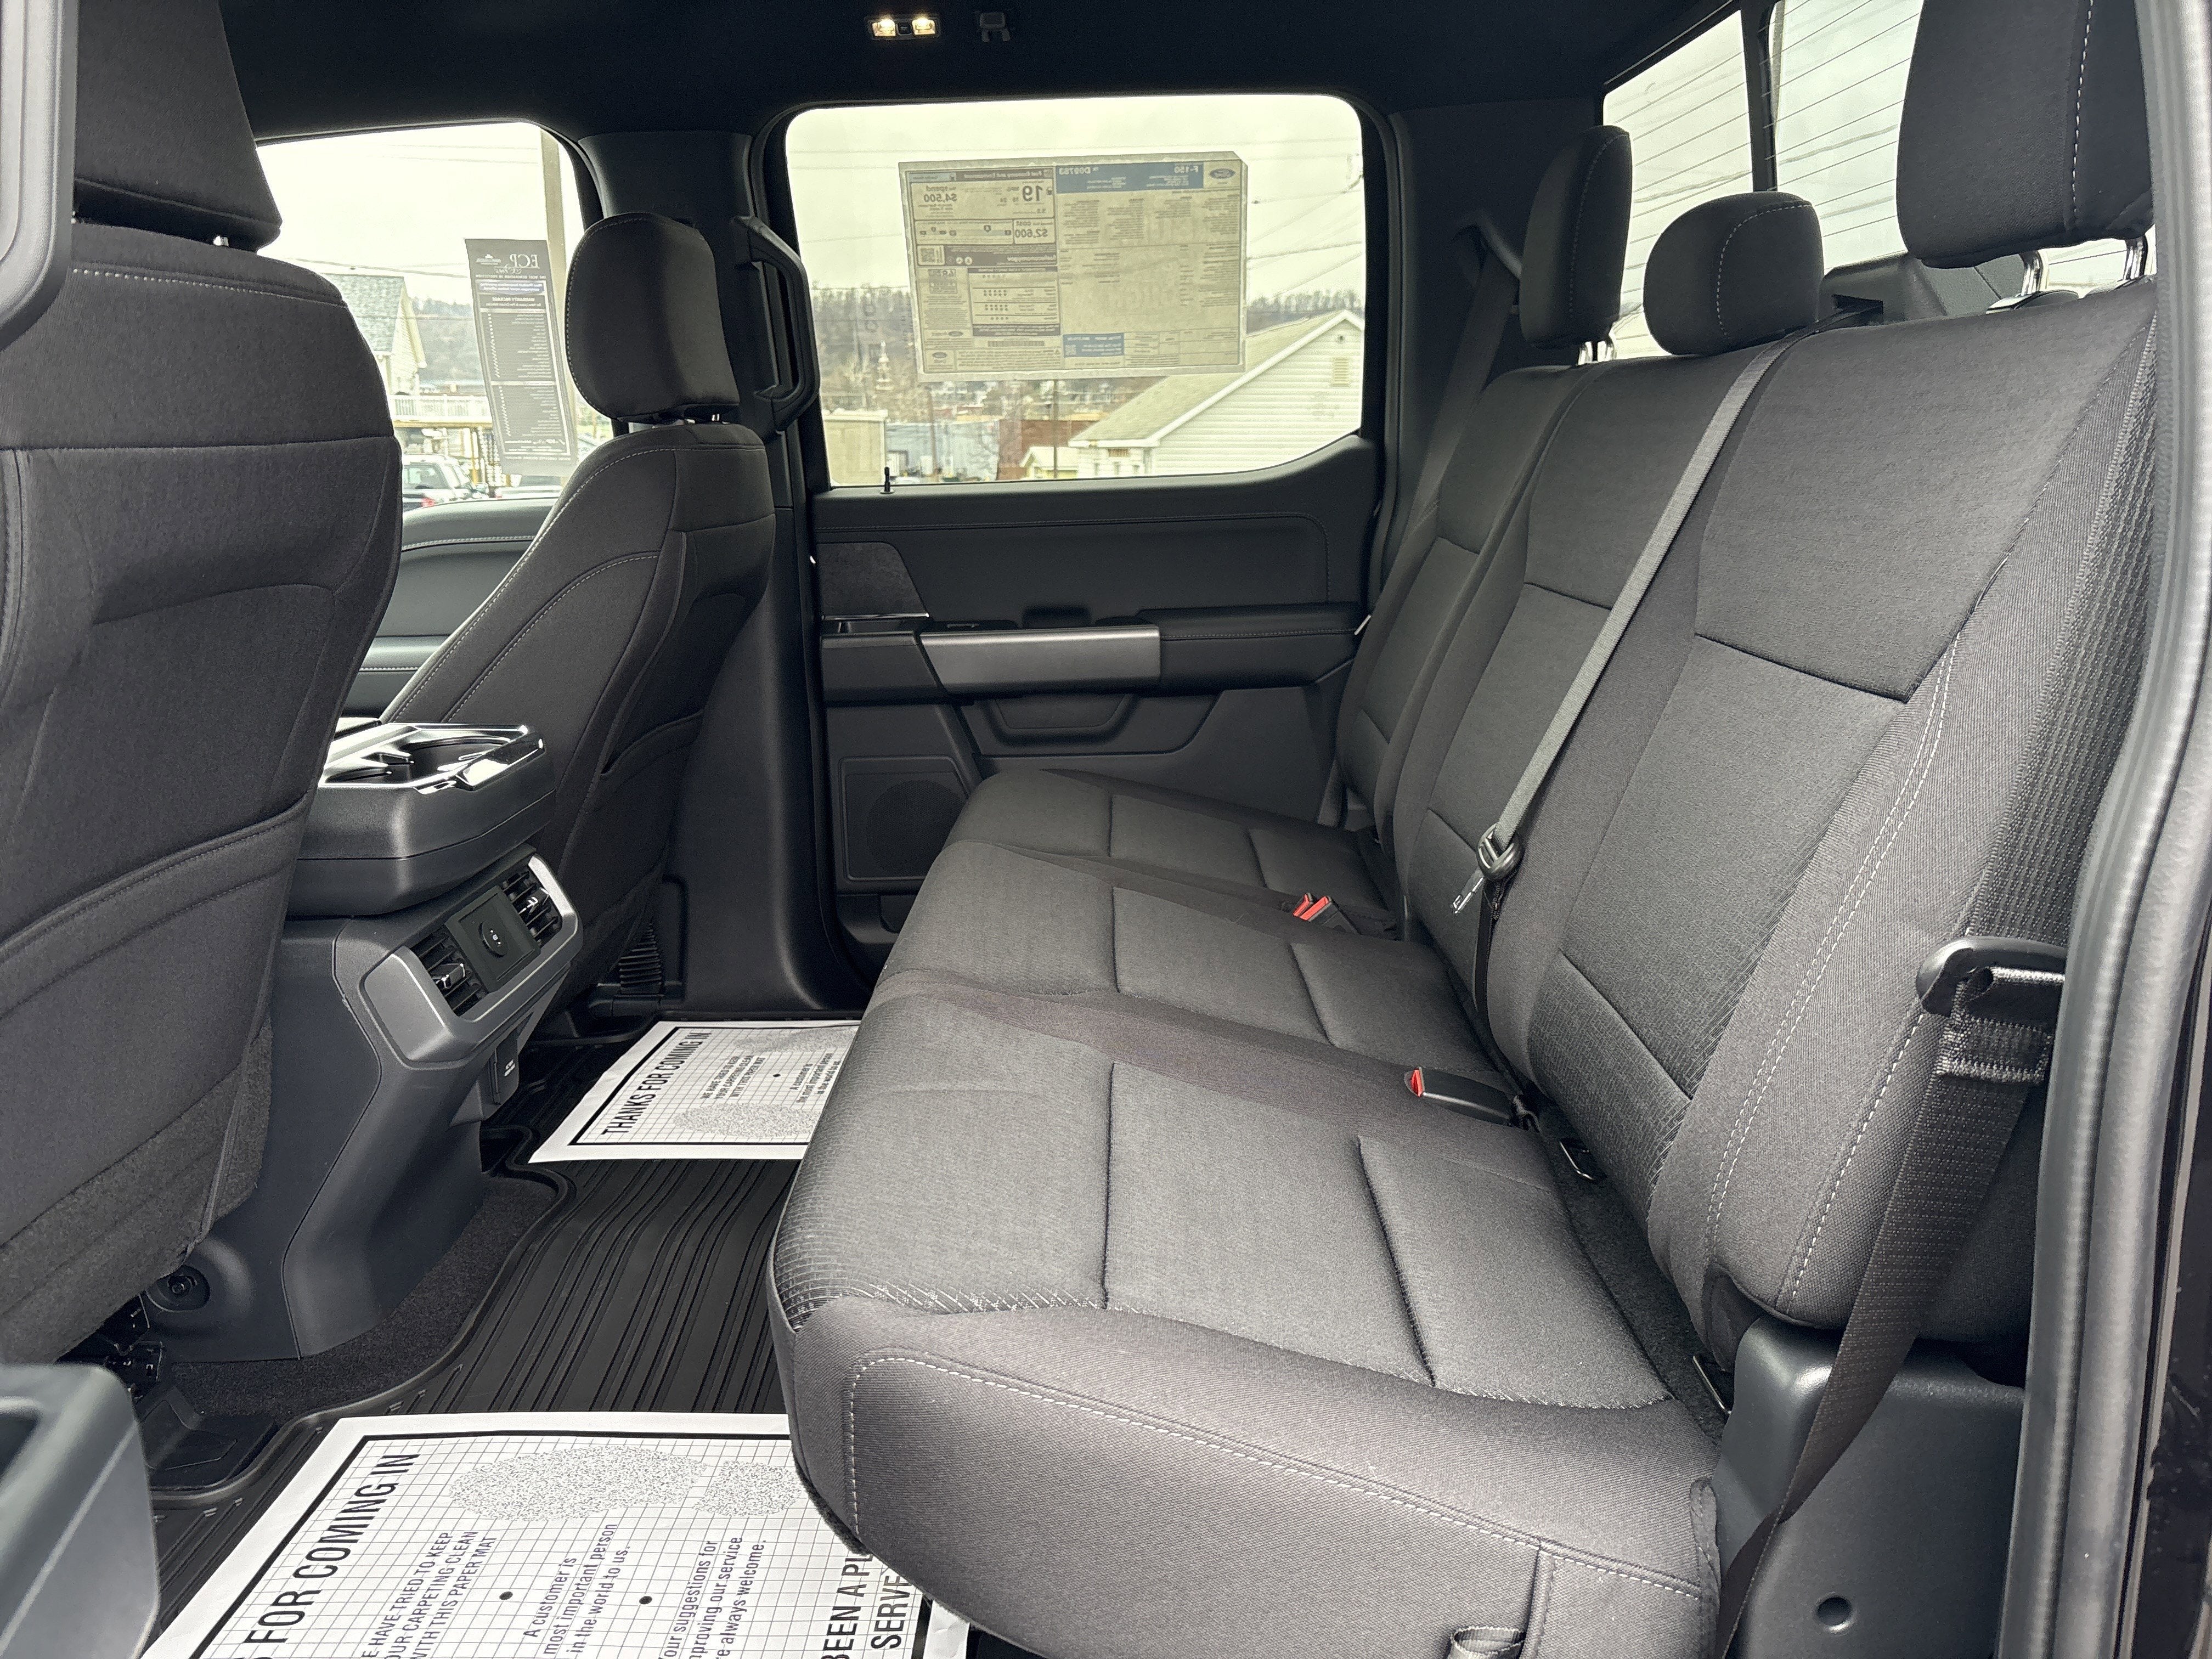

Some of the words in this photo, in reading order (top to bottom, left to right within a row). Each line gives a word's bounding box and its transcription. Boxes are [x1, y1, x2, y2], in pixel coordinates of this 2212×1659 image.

[685, 1031, 713, 1040] IN
[654, 1041, 704, 1070] COMING
[636, 1073, 675, 1091] FOR
[601, 1093, 657, 1135] THANKS
[242, 1589, 324, 1644] FOR
[291, 1482, 399, 1579] COMING
[369, 1454, 421, 1475] IN
[612, 1545, 631, 1564] us.
[718, 1537, 743, 1581] service
[368, 1615, 400, 1647] HAVE
[389, 1578, 424, 1615] TRIED
[414, 1561, 435, 1576] TO
[426, 1532, 453, 1560] KEEP
[431, 1600, 459, 1628] THIS
[448, 1560, 482, 1596] PAPER
[473, 1537, 498, 1558] MAT
[543, 1624, 568, 1655] most
[562, 1564, 599, 1622] important
[590, 1523, 618, 1561] person
[603, 1567, 621, 1581] to
[710, 1582, 727, 1602] our
[719, 1600, 747, 1645] always
[737, 1539, 766, 1596] welcome.
[836, 1583, 867, 1598] A
[383, 1635, 413, 1659] OUR
[401, 1567, 455, 1632] CARPETING
[444, 1531, 479, 1565] CLEAN
[522, 1628, 541, 1638] A
[533, 1569, 570, 1625] customer
[557, 1557, 577, 1569] is
[587, 1581, 615, 1615] world
[658, 1635, 684, 1659] our
[673, 1560, 713, 1633] suggestions
[698, 1541, 719, 1556] for
[566, 1634, 588, 1654] in
[575, 1618, 597, 1644] the
